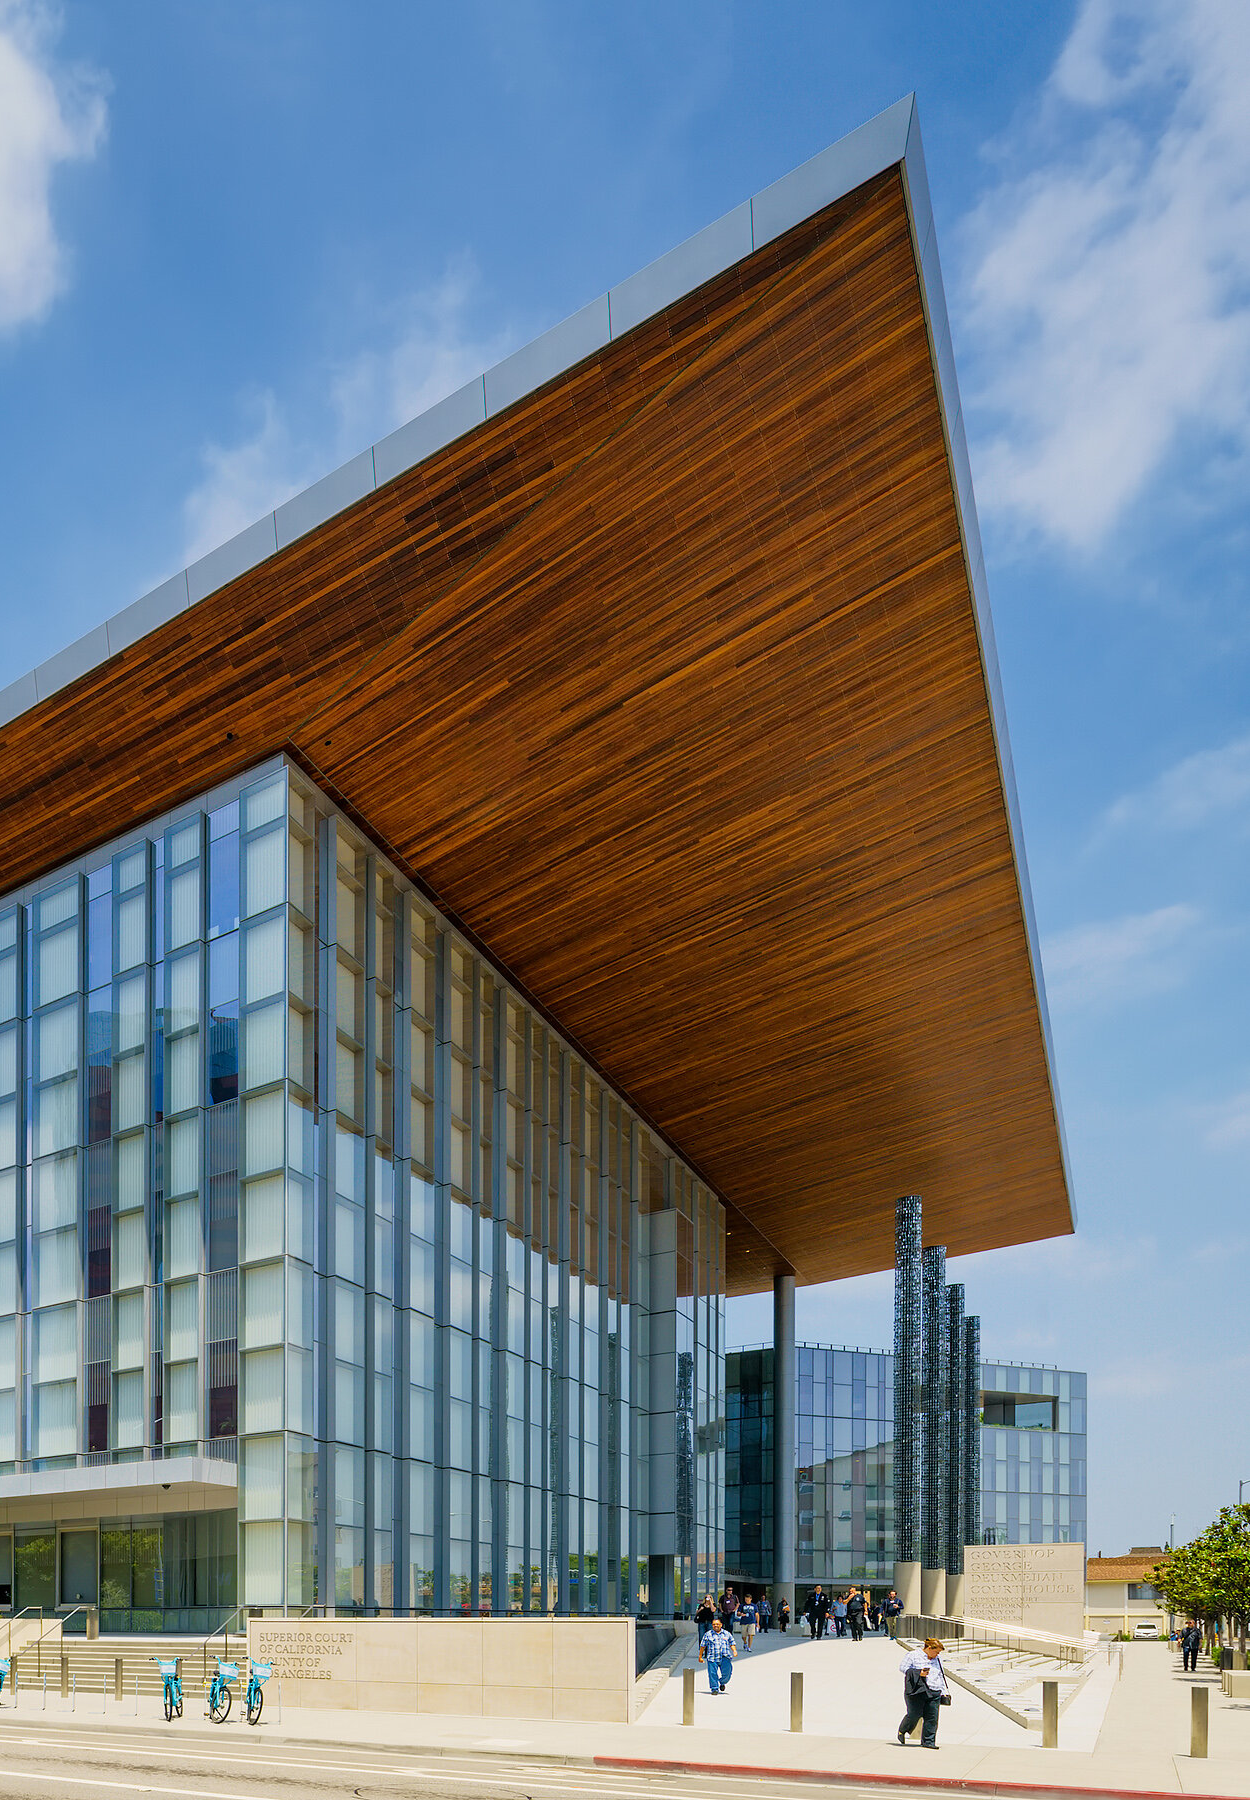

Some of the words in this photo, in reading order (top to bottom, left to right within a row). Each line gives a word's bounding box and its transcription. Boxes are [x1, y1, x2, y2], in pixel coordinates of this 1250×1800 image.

[970, 1549, 1055, 1560] GOVERNOR
[970, 1561, 1032, 1571] GEORGE
[971, 1573, 1063, 1582] DEUKMEJIAN
[970, 1584, 1076, 1594] COURTHOUSE
[259, 1632, 314, 1642] SUPERIOR
[314, 1633, 354, 1643] COURT
[259, 1644, 274, 1654] OF
[275, 1644, 343, 1655] CALIFORNIA
[306, 1657, 321, 1667] OF
[280, 1669, 332, 1679] ANGELES
